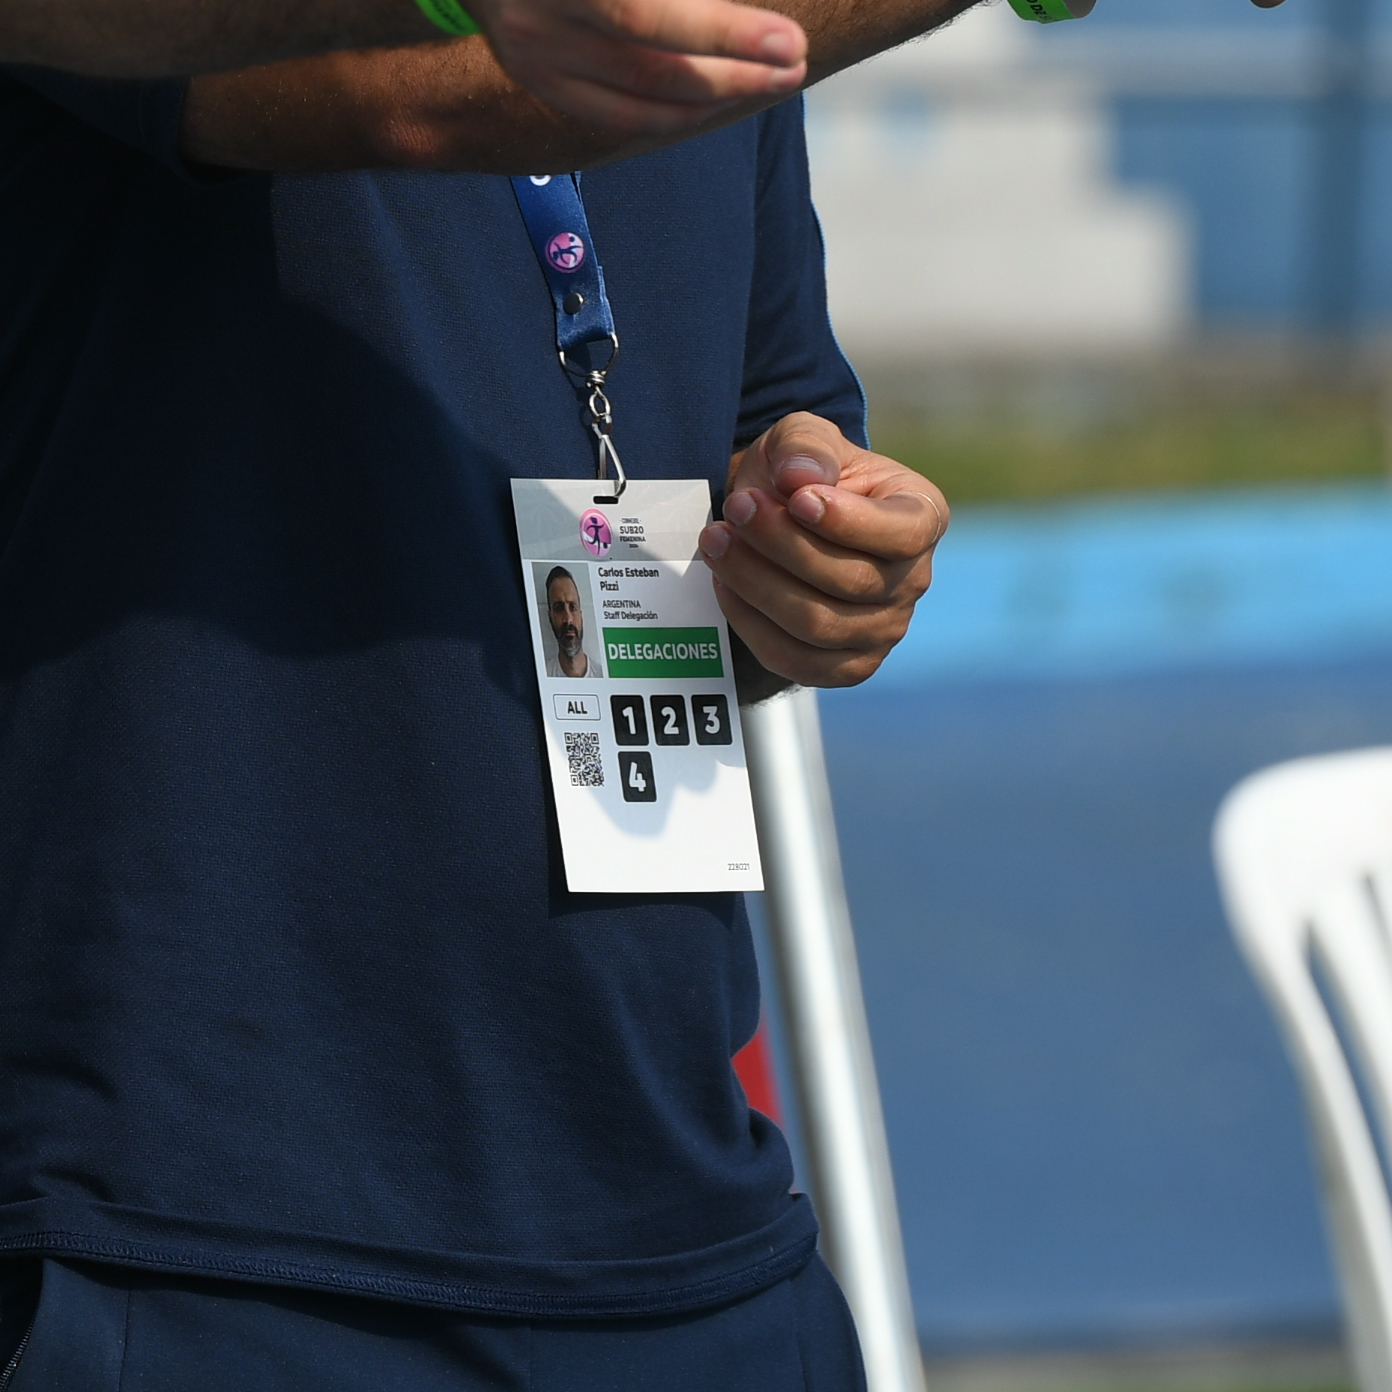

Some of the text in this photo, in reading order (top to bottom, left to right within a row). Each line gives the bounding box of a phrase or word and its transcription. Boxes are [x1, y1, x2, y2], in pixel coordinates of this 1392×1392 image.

[619, 525, 645, 535] SUB20
[598, 567, 659, 578] Carlos Esteban
[600, 580, 619, 591] Pizzi
[602, 599, 641, 609] ARGENTINA
[603, 610, 658, 621] Staff Delegación
[608, 643, 718, 660] DELEGACIONES
[567, 700, 588, 715] ALL
[622, 706, 721, 735] 1 2 3
[629, 761, 647, 792] 4
